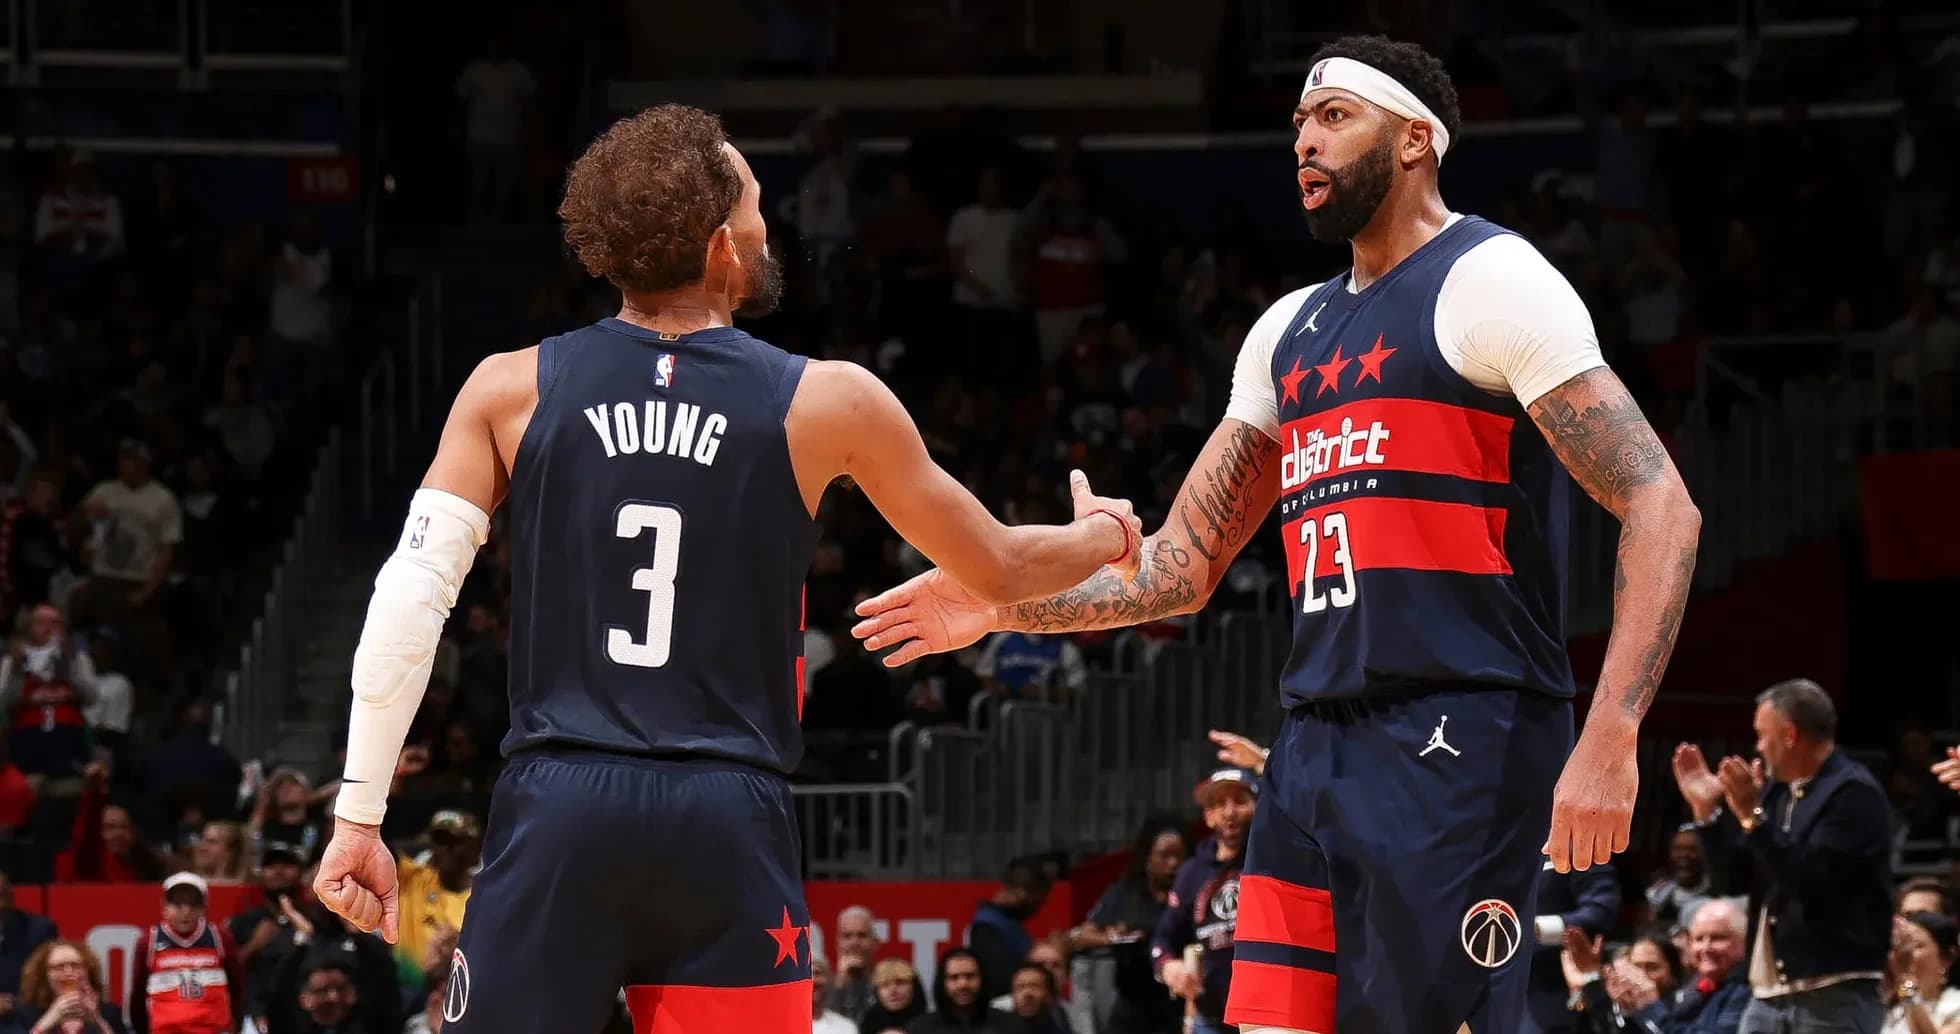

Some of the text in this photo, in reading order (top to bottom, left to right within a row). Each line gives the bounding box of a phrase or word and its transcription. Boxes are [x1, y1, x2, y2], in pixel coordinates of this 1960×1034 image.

[583, 400, 728, 467] YOUNG
[1605, 442, 1662, 482] CHICAGO
[1283, 499, 1299, 514] OF
[606, 503, 683, 668] 3
[1300, 512, 1356, 614] 23
